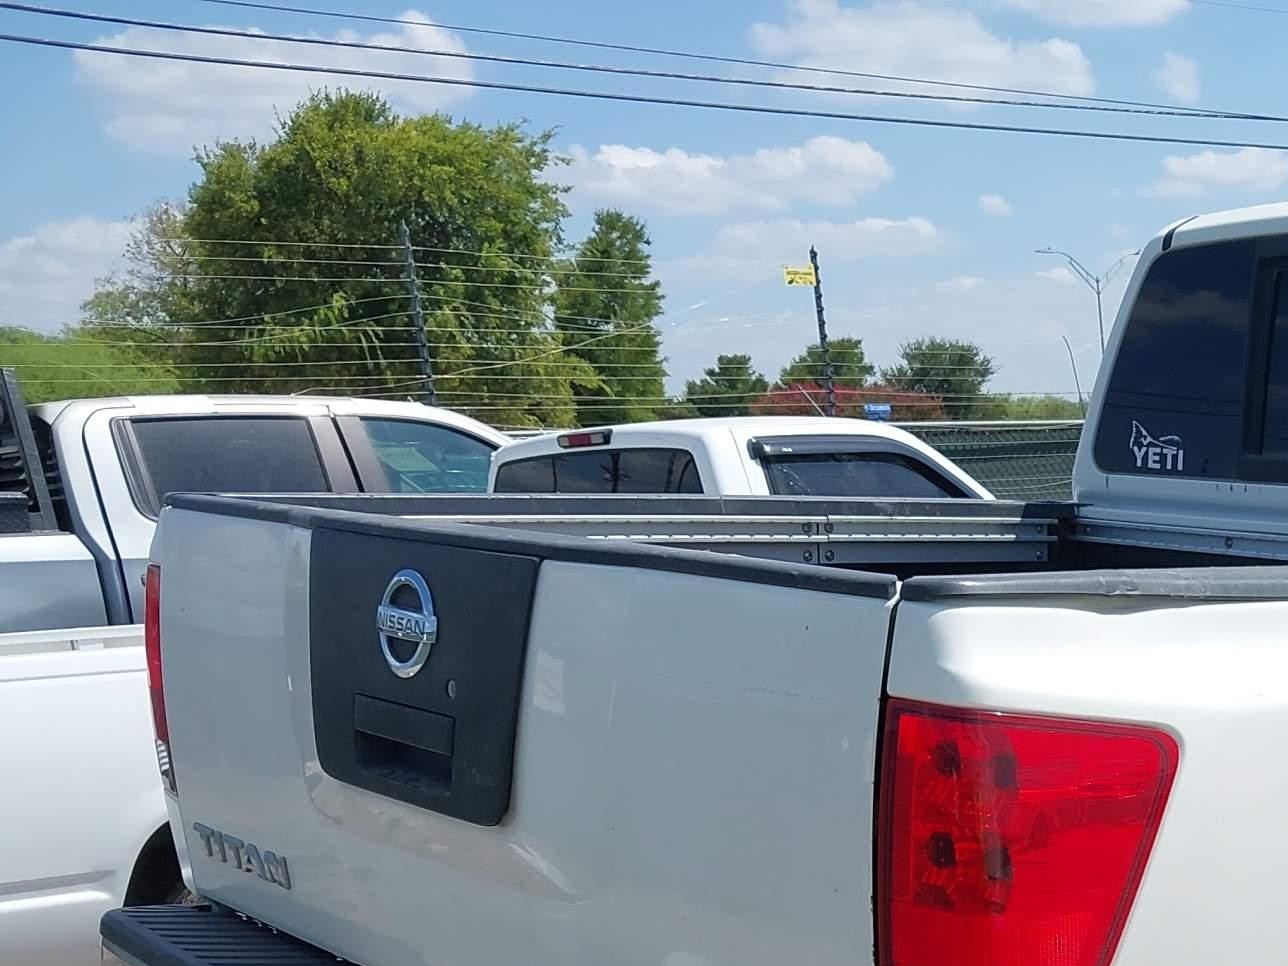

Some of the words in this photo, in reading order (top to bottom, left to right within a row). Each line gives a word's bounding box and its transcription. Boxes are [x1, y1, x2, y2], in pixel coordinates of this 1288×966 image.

[1132, 445, 1184, 471] YETI
[377, 611, 426, 635] NISSAN
[193, 822, 292, 890] TITAN
